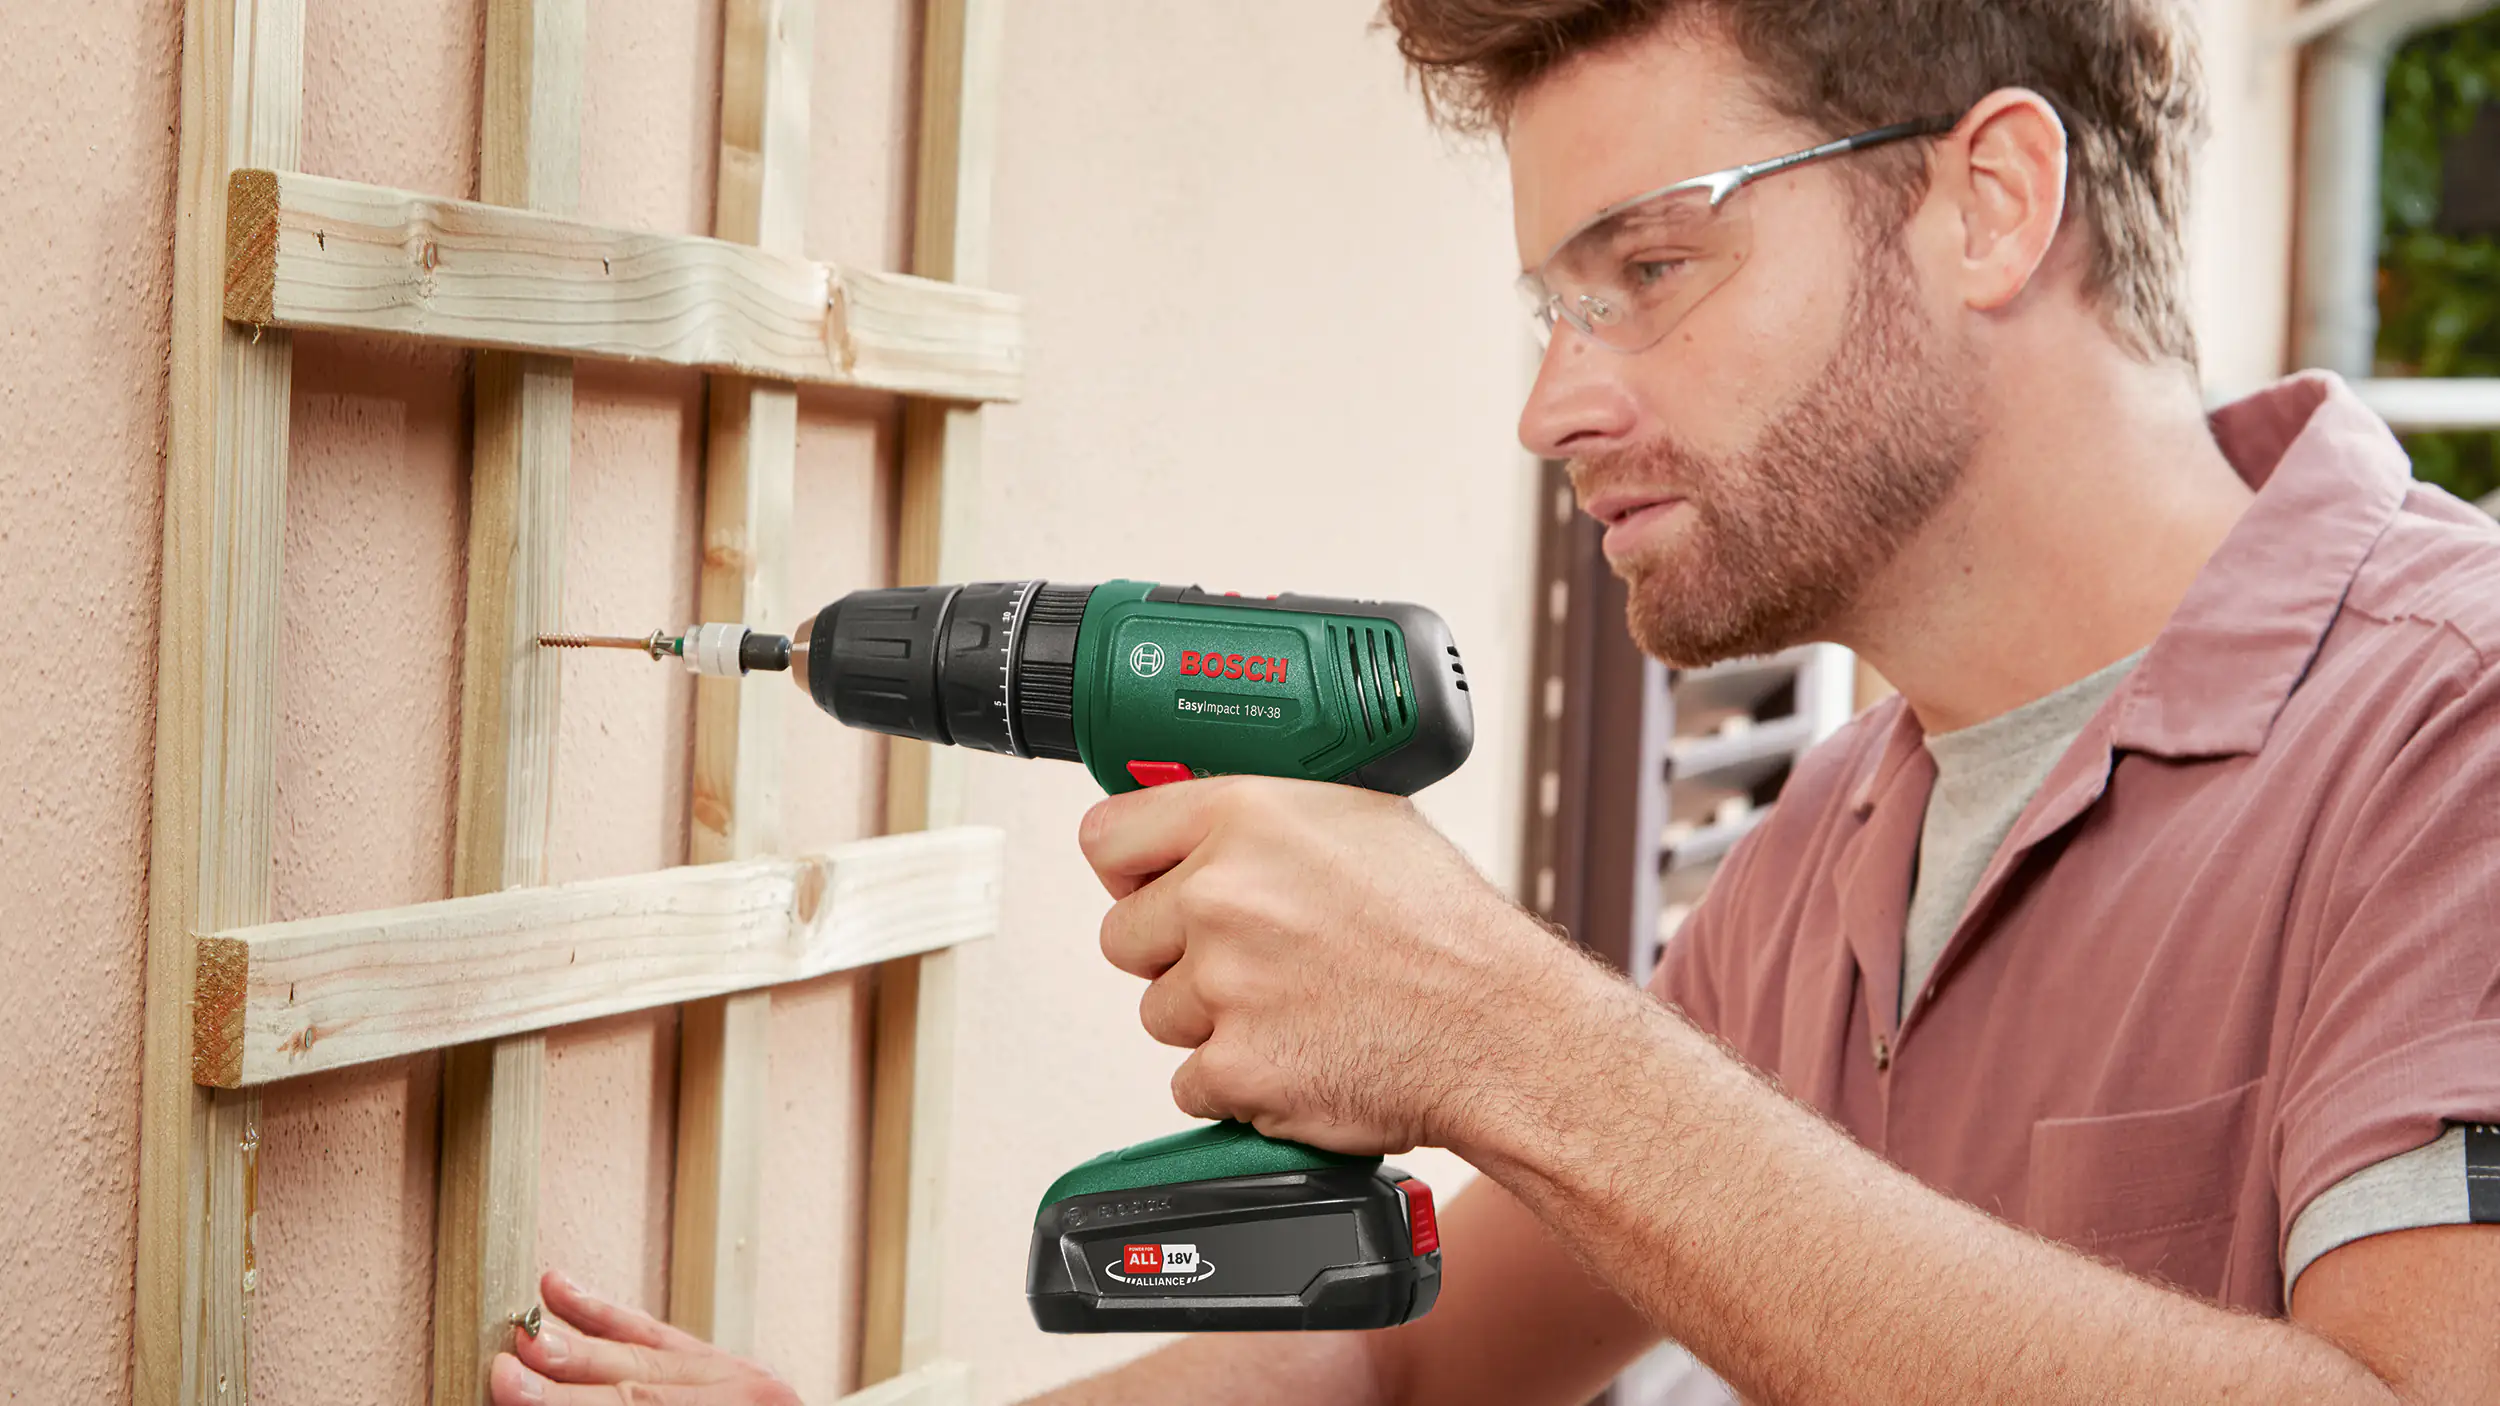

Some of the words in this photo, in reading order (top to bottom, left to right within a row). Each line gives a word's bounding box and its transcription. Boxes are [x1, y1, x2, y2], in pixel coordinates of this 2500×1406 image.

[1180, 650, 1288, 683] BOSCH
[1178, 698, 1241, 715] EasyImpact
[1244, 704, 1281, 719] 18V-38
[1129, 1253, 1158, 1265] ALL
[1167, 1252, 1192, 1265] 18V
[1136, 1277, 1185, 1287] ALLIANCE
